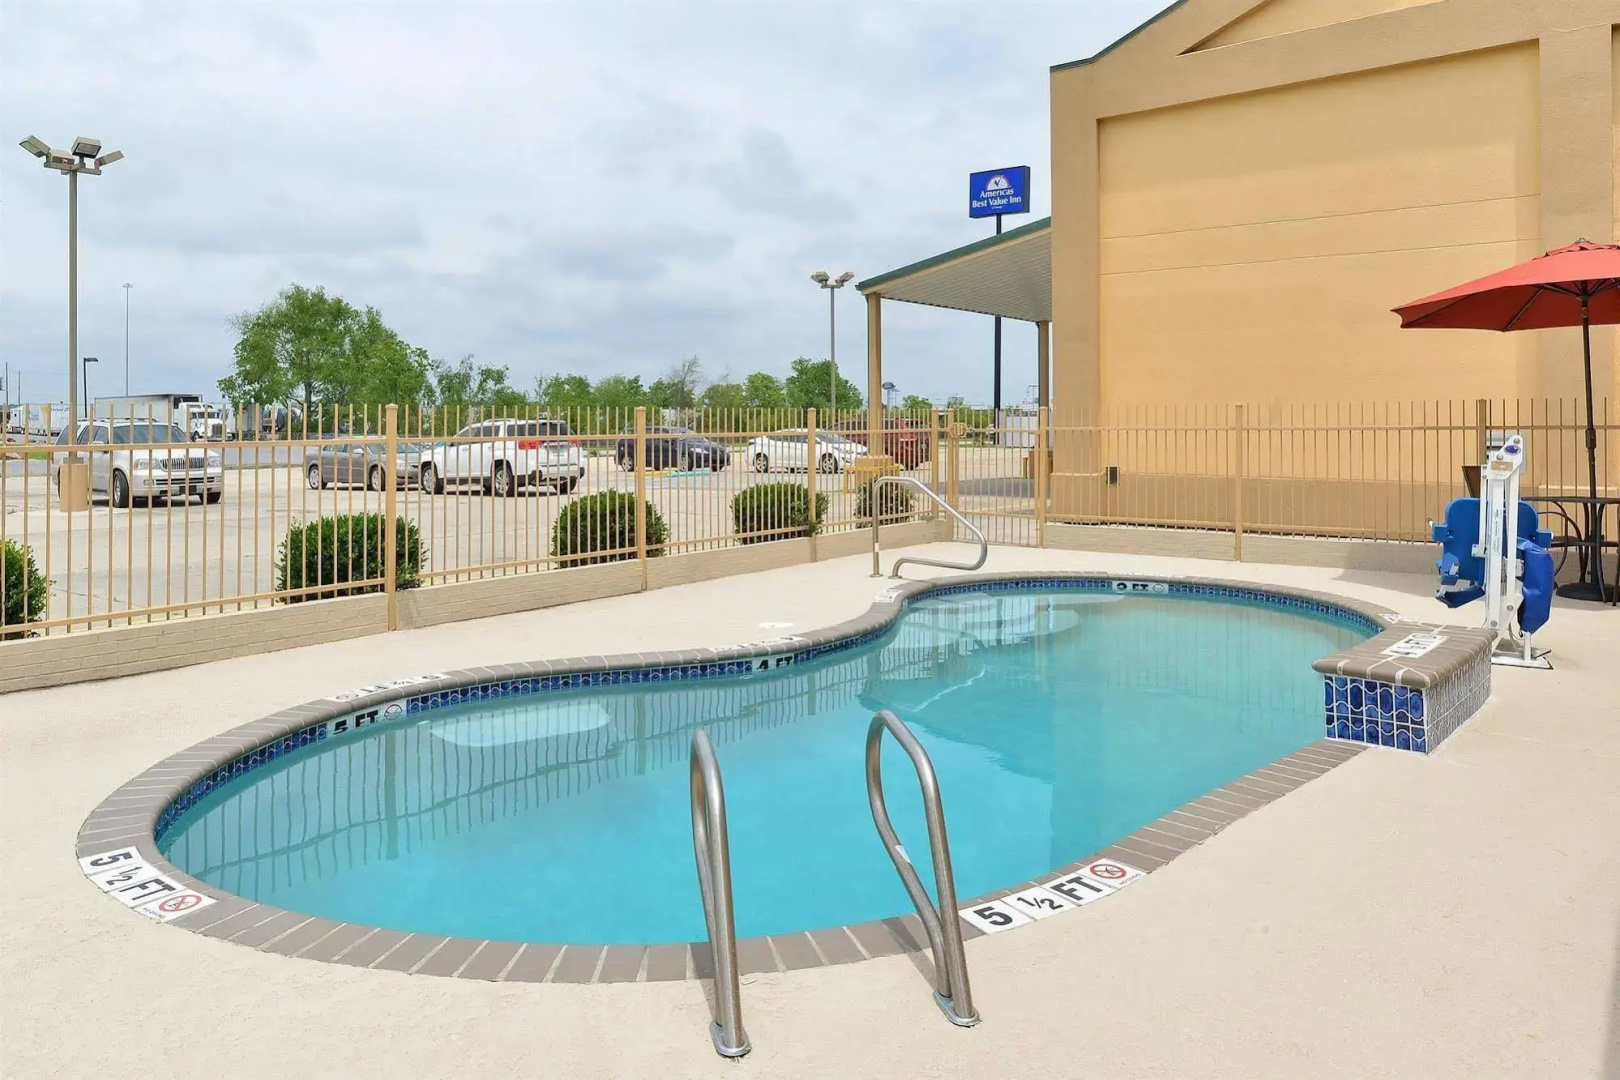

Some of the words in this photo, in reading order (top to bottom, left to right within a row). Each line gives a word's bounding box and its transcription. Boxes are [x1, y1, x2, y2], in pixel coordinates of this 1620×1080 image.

[972, 200, 987, 208] Best
[989, 197, 1008, 206] Value
[980, 188, 1014, 198] Americas
[333, 720, 348, 735] 5
[355, 710, 379, 728] FT
[90, 852, 133, 867] 5
[119, 878, 176, 900] FT
[973, 906, 1013, 926] 5
[1050, 876, 1103, 901] FT
